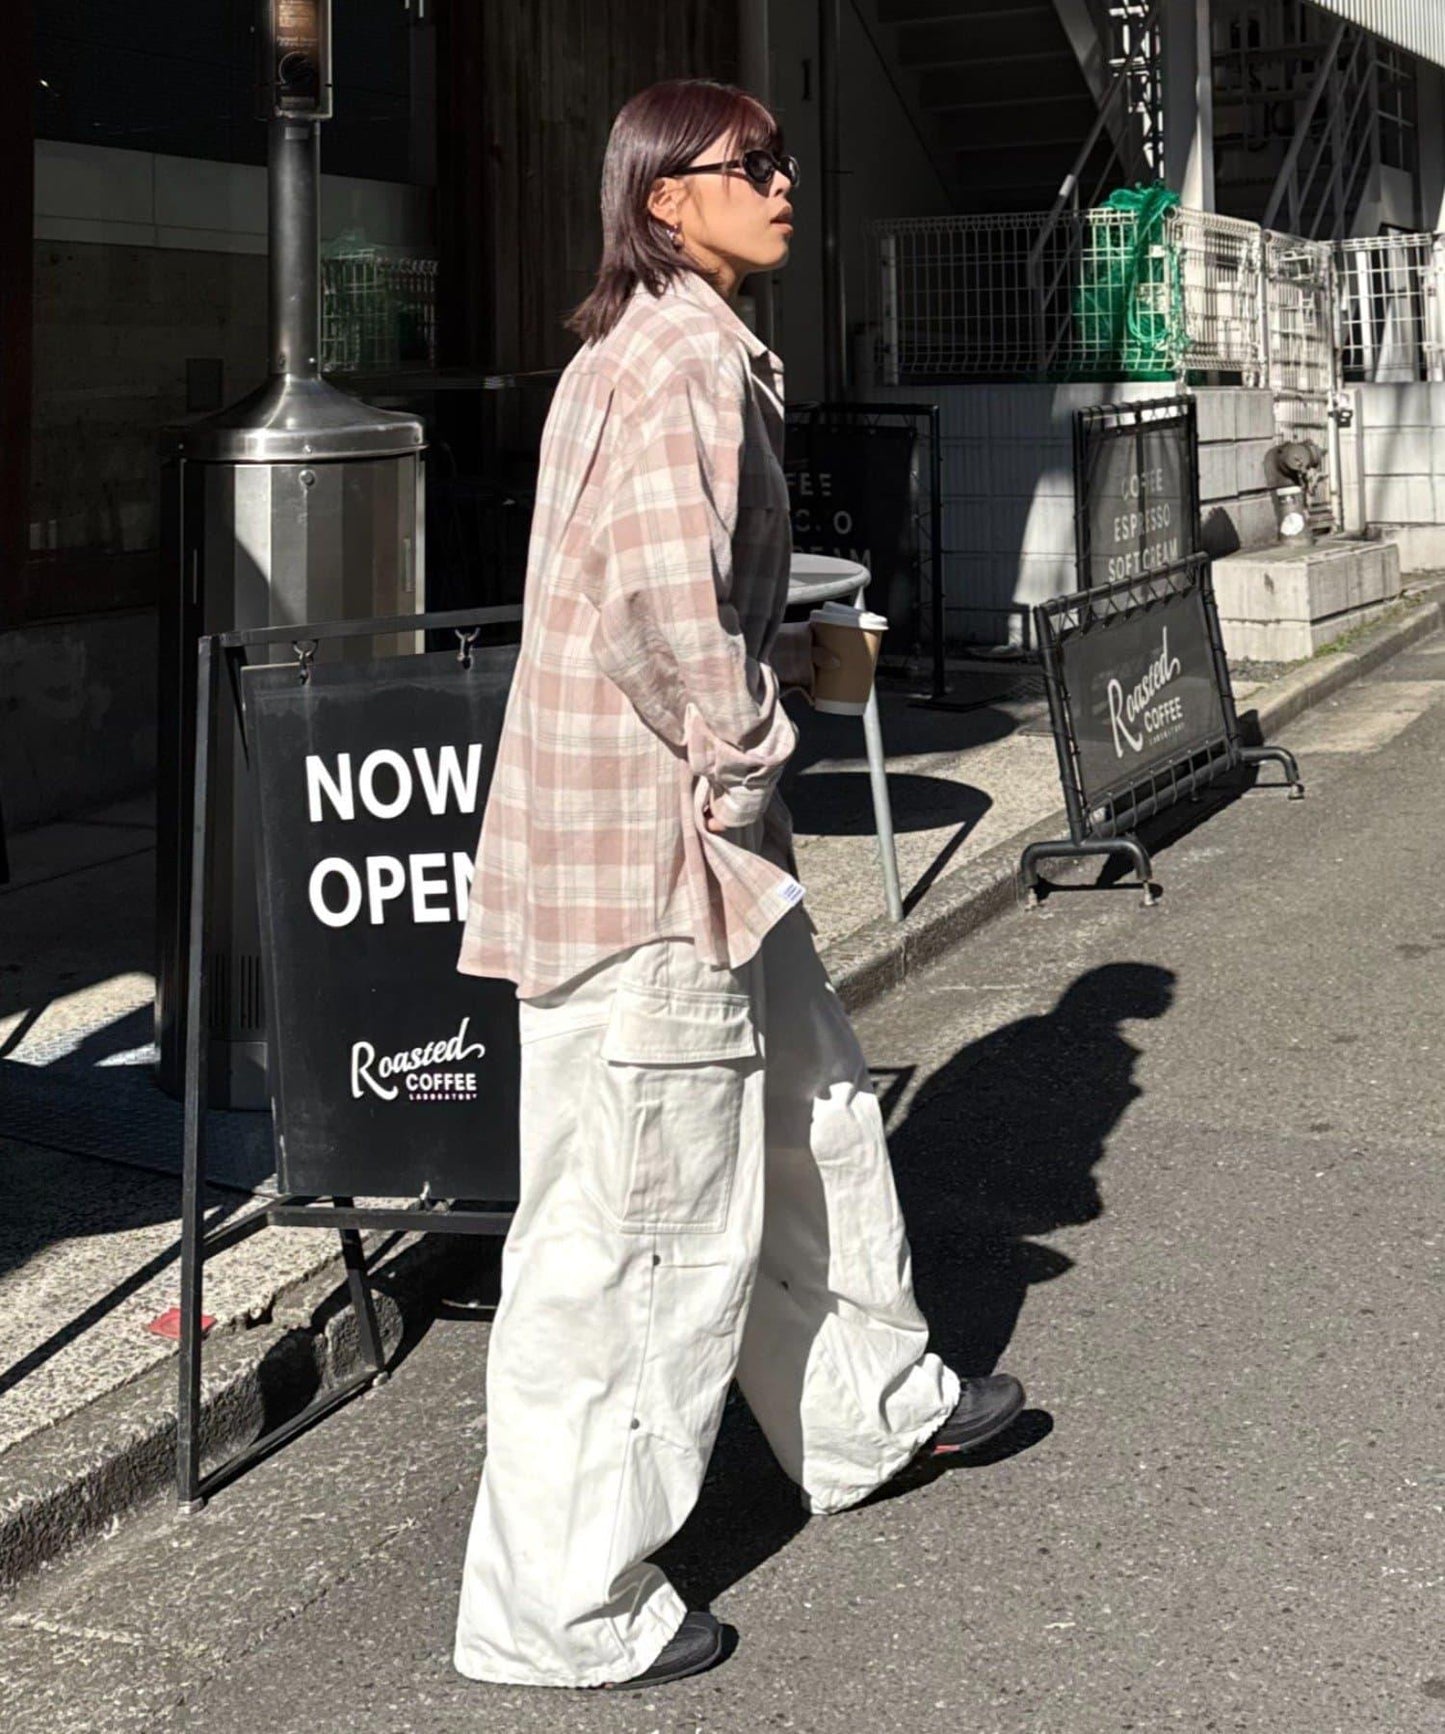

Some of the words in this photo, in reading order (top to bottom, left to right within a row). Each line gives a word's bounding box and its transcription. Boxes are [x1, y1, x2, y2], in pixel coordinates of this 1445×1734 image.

[1108, 551, 1140, 582] SOFT
[1142, 537, 1178, 573] CREAM
[1107, 625, 1181, 758] Roasted
[1144, 697, 1183, 733] COFFEE
[306, 744, 482, 822] NOW
[351, 1017, 485, 1100] Roasted
[405, 1073, 477, 1091] COFFEE
